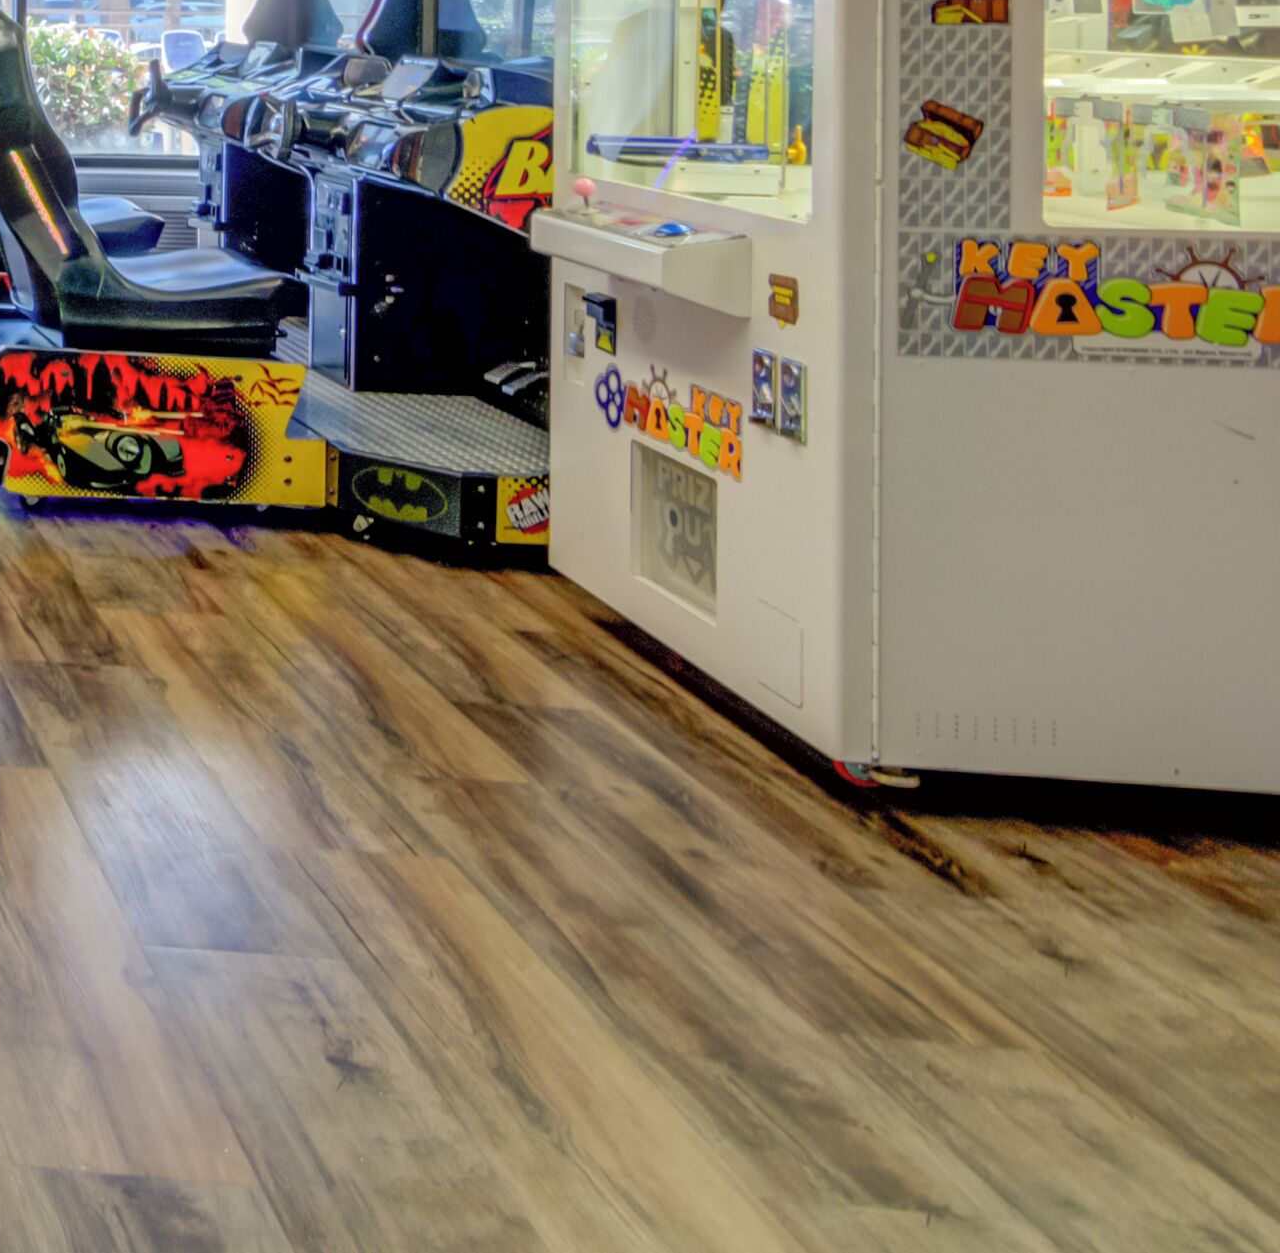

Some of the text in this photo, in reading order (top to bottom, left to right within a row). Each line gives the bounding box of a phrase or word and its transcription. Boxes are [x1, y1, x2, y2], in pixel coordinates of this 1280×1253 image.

[960, 239, 1100, 281] KEY
[624, 383, 742, 482] MASTER
[693, 386, 741, 434] KEY
[657, 459, 713, 514] PRIZ
